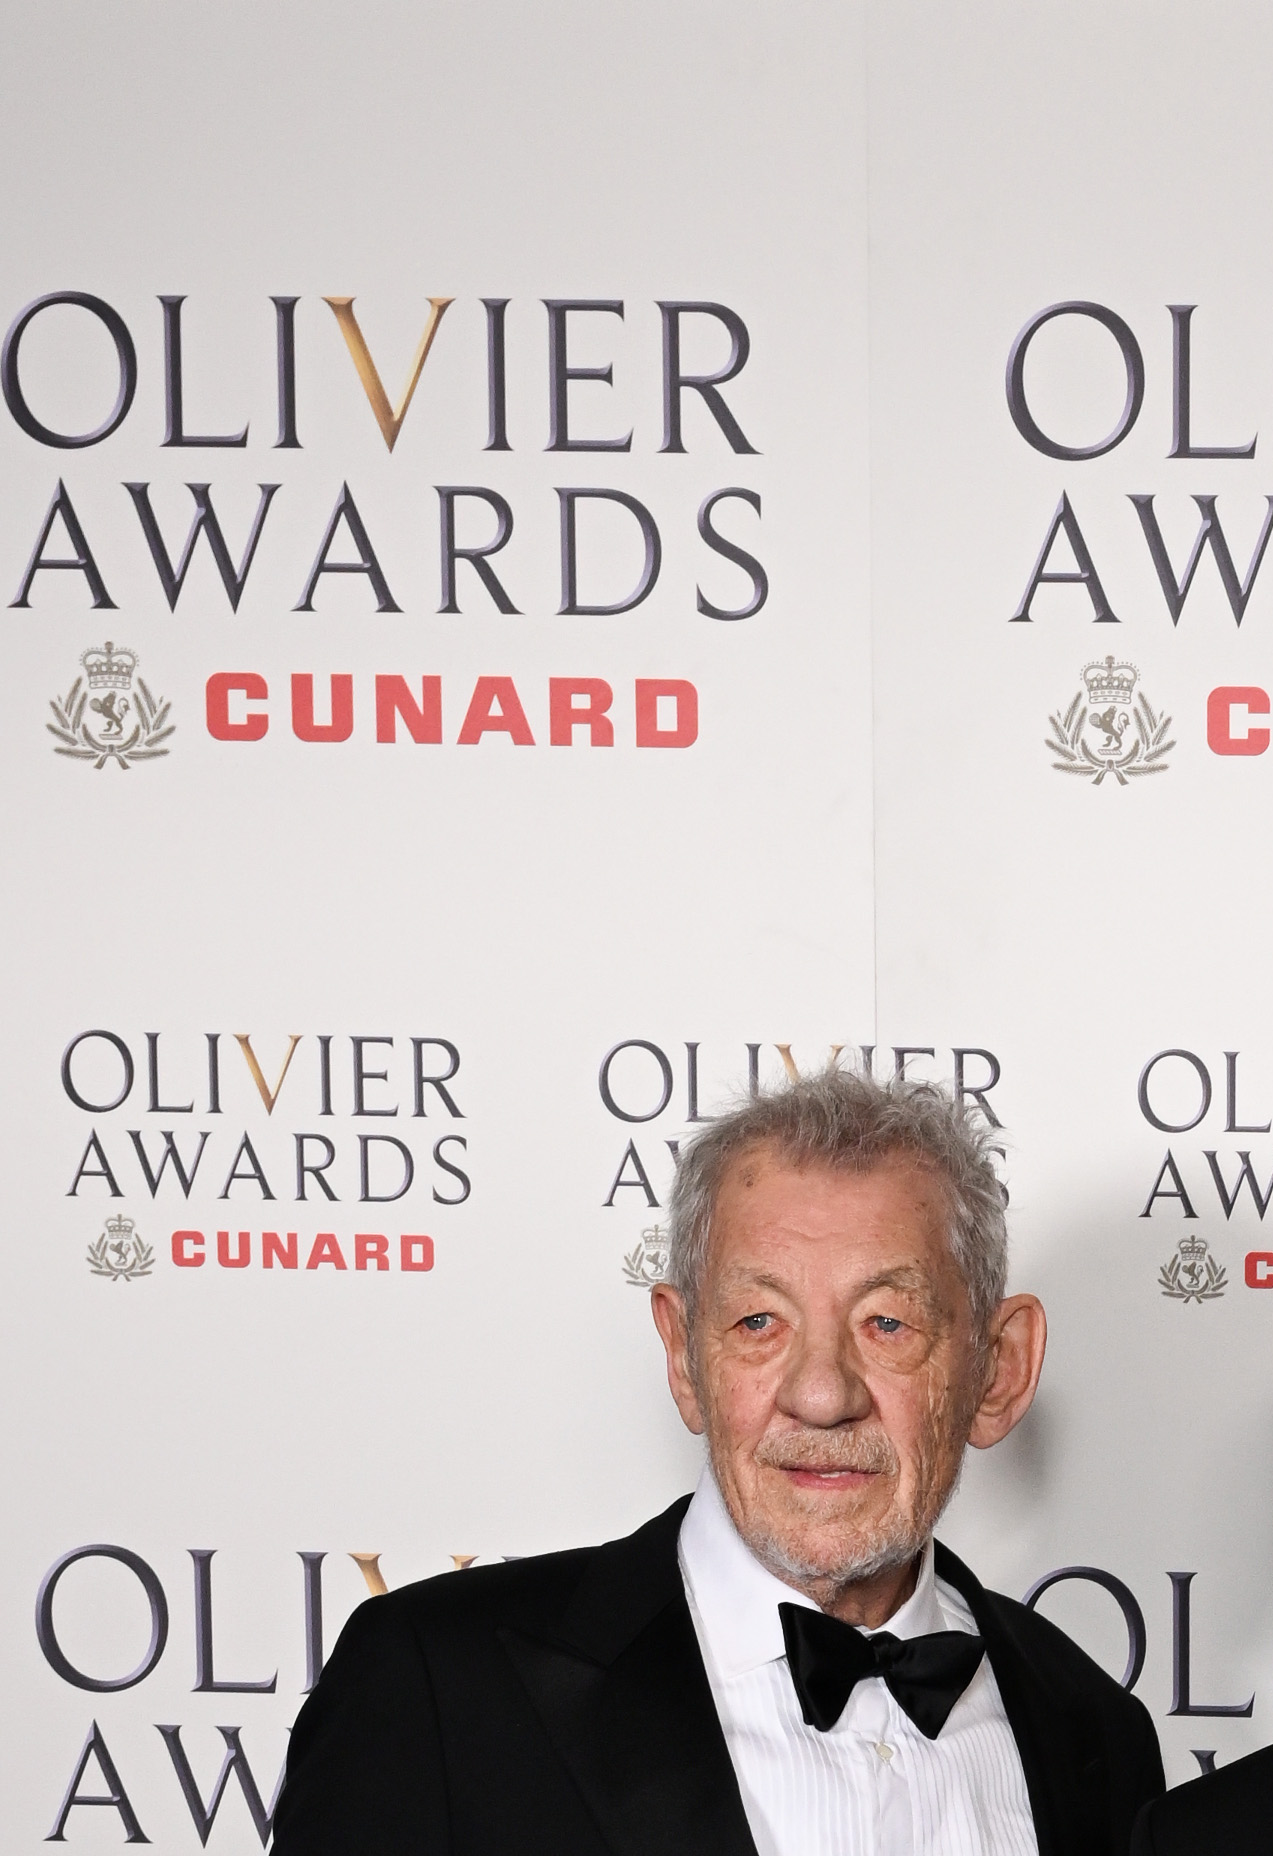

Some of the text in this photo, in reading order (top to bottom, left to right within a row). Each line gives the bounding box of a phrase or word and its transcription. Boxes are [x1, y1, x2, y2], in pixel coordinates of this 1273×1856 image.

[0, 290, 763, 454] OLIVIER
[6, 477, 769, 621] AWARDS
[205, 671, 699, 748] CUNARD
[60, 1029, 467, 1119] OLIVIER
[65, 1128, 472, 1206] AWARDS
[171, 1229, 435, 1272] CUNARD
